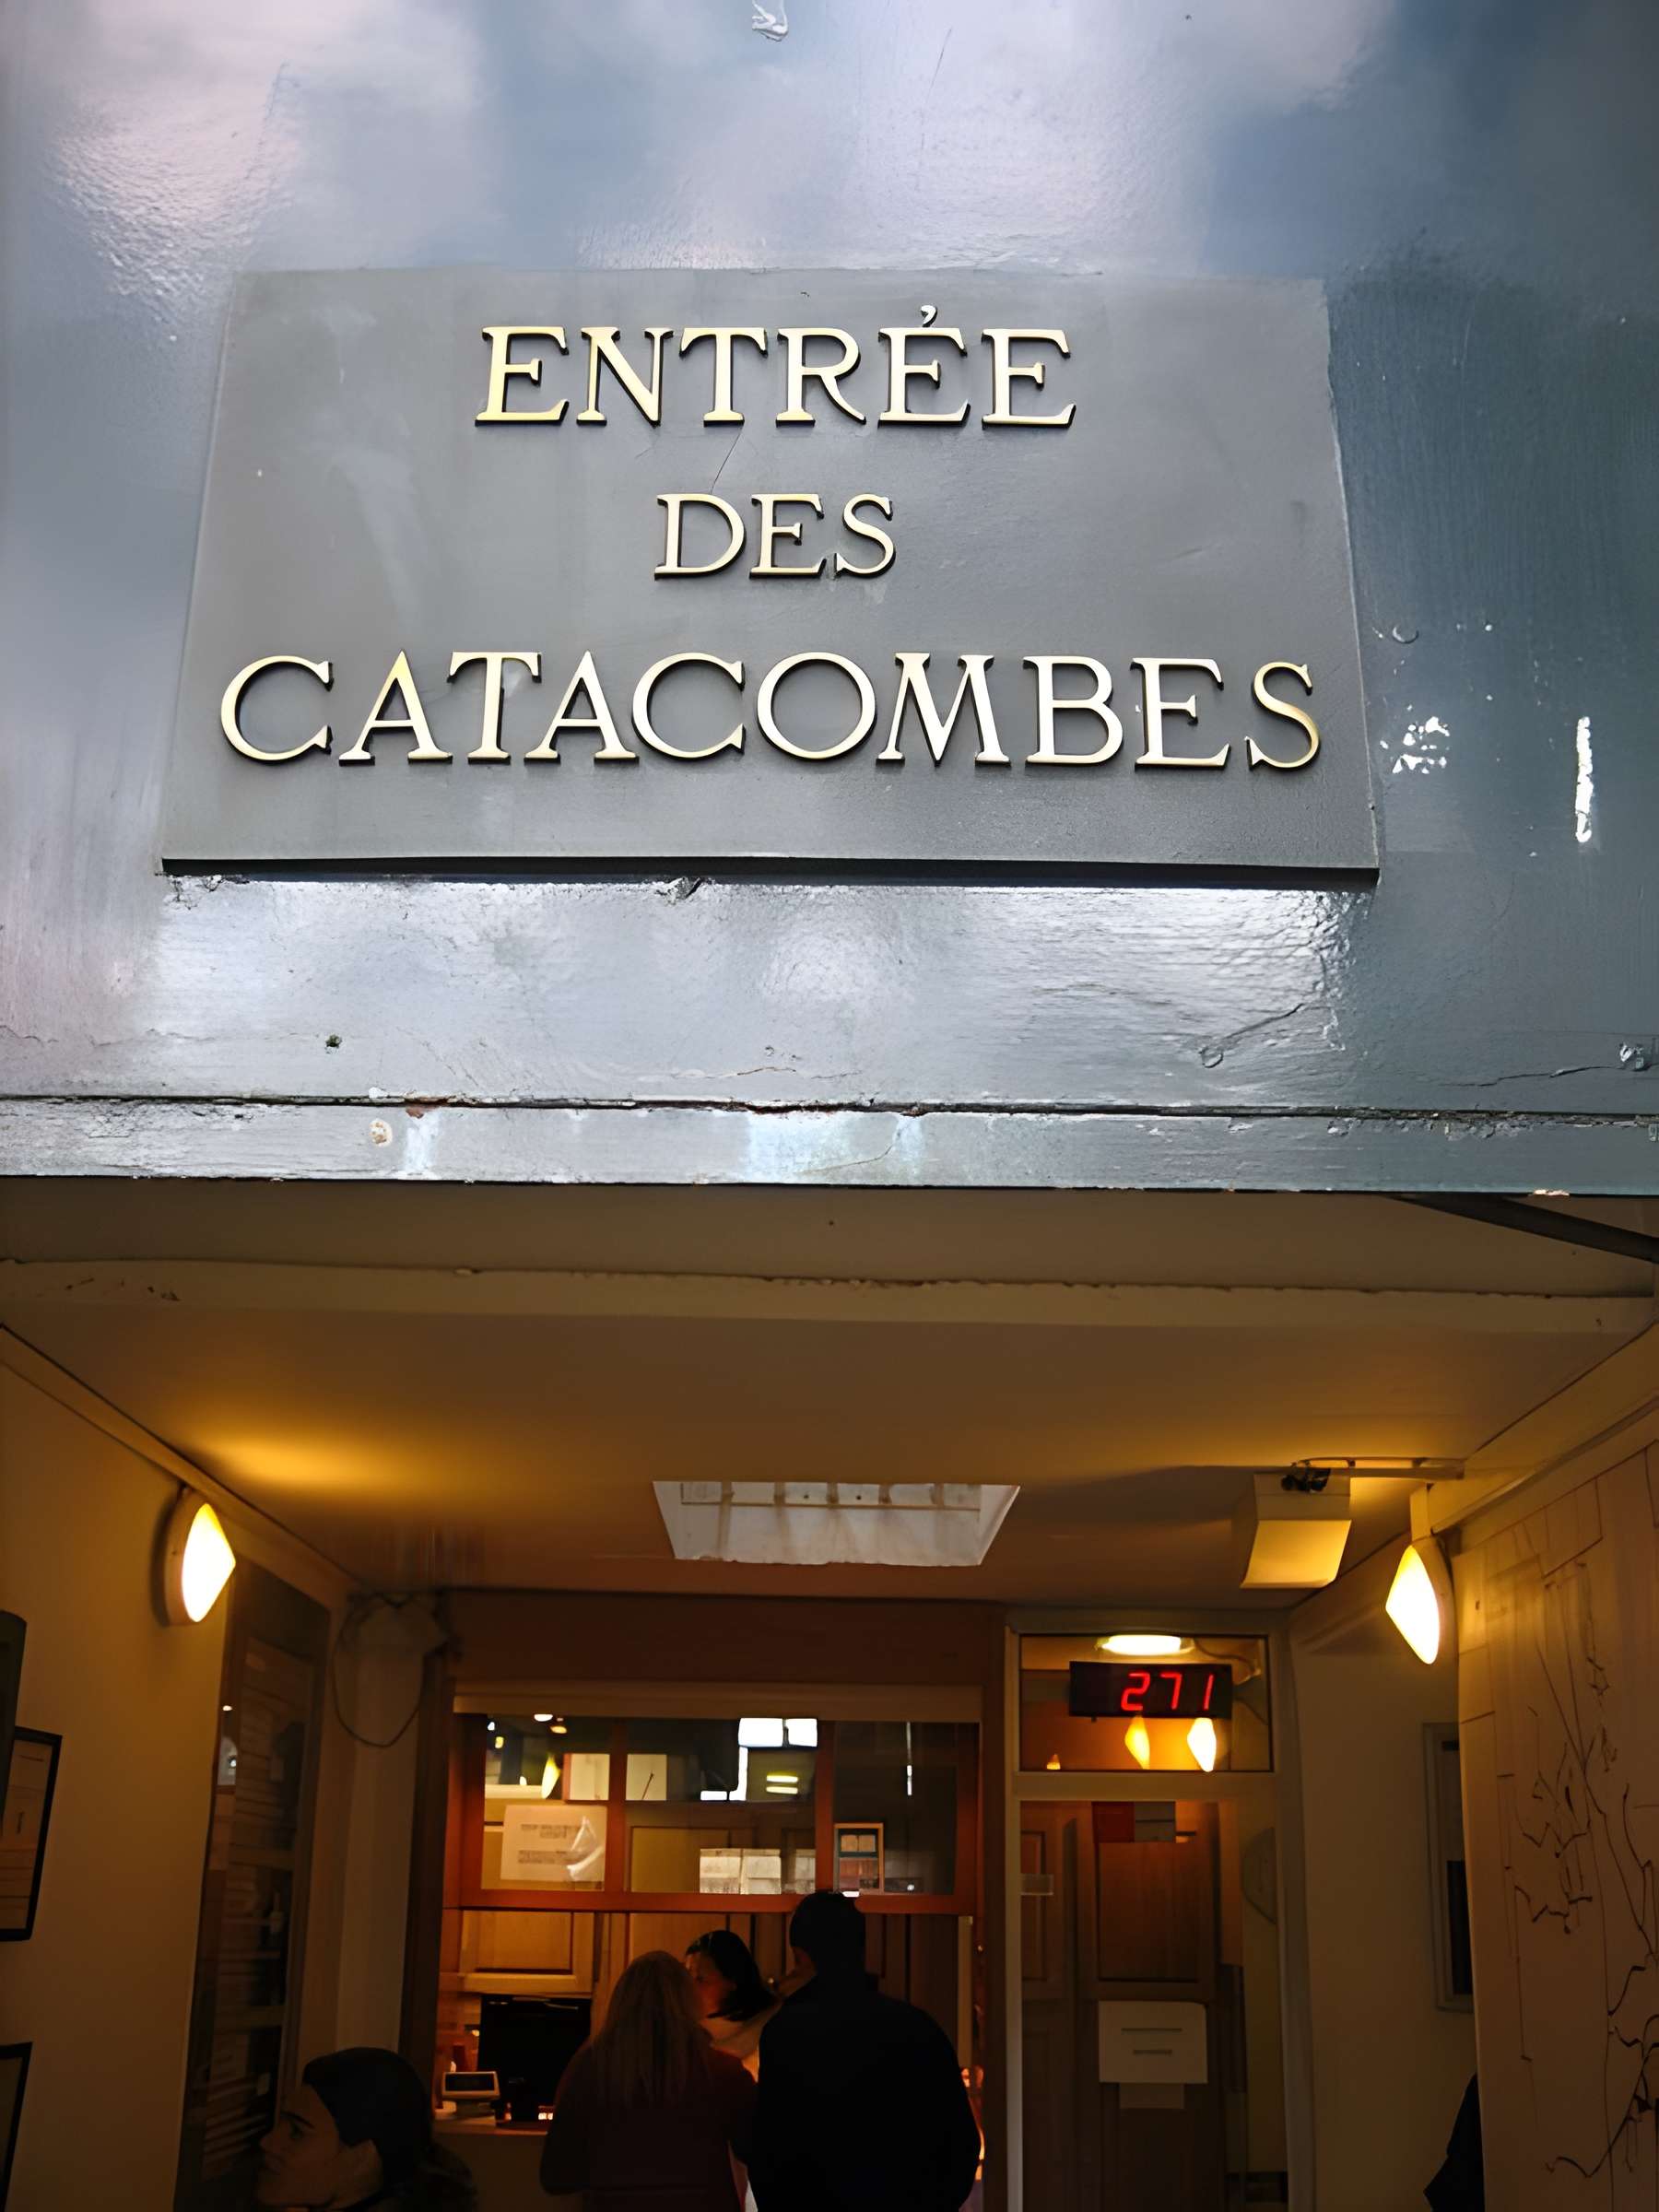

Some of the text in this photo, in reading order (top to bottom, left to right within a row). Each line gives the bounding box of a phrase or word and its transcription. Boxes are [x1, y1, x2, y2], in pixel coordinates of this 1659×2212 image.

[476, 305, 1076, 428] ENTRÉE
[654, 492, 896, 579] DES
[220, 650, 1320, 771] CATACOMBES
[1121, 1672, 1215, 1712] 271
